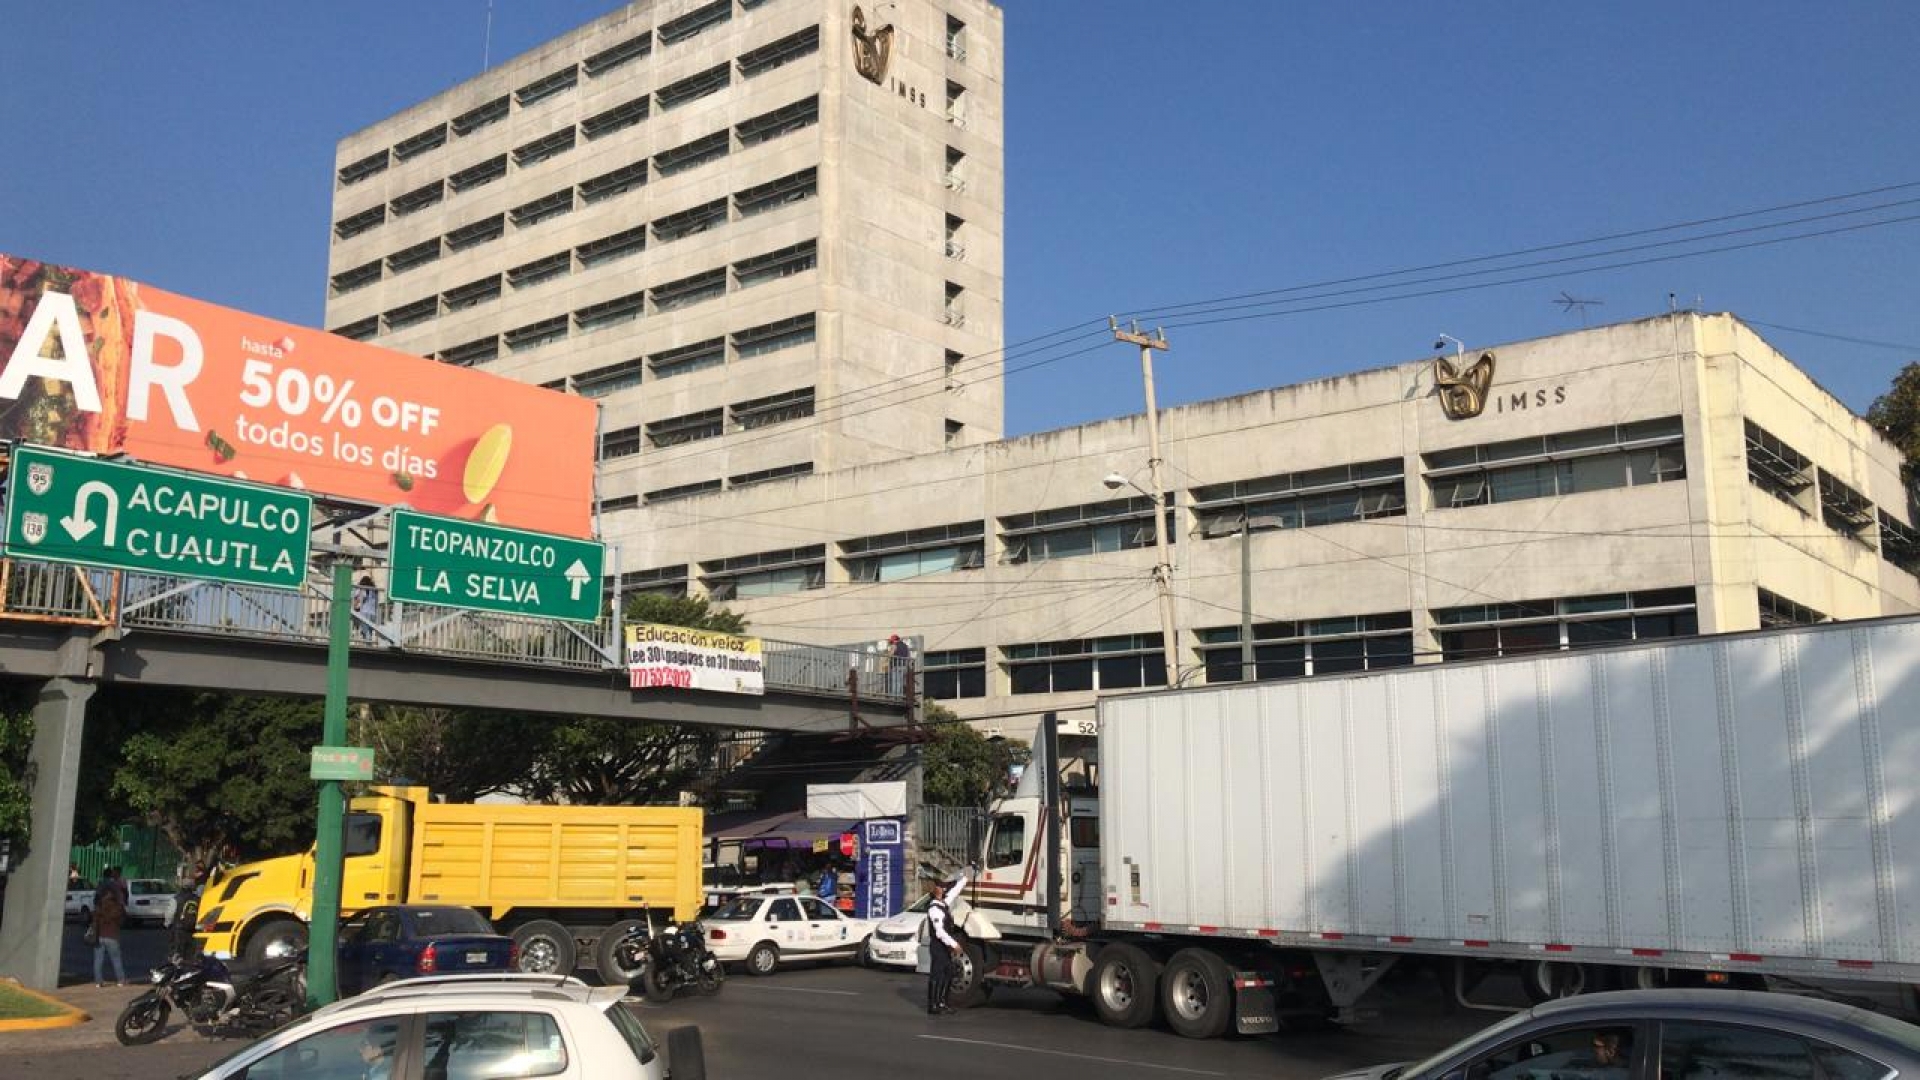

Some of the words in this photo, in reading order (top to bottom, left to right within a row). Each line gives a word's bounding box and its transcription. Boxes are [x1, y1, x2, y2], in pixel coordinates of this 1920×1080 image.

[890, 76, 926, 109] IMSS
[241, 335, 283, 358] hasta
[239, 358, 362, 428] 50%
[371, 395, 441, 436] OFF
[1497, 386, 1567, 413] IMSS
[235, 413, 325, 457] todos
[333, 431, 373, 466] los
[381, 445, 438, 479] días
[126, 483, 301, 535] ACAPULCO
[26, 523, 43, 535] 138
[408, 525, 556, 568] TEOPANZOLCO
[126, 528, 295, 575] CUAUTLA
[416, 567, 451, 594] LA
[465, 573, 541, 605] SELVA
[1078, 721, 1099, 734] 52
